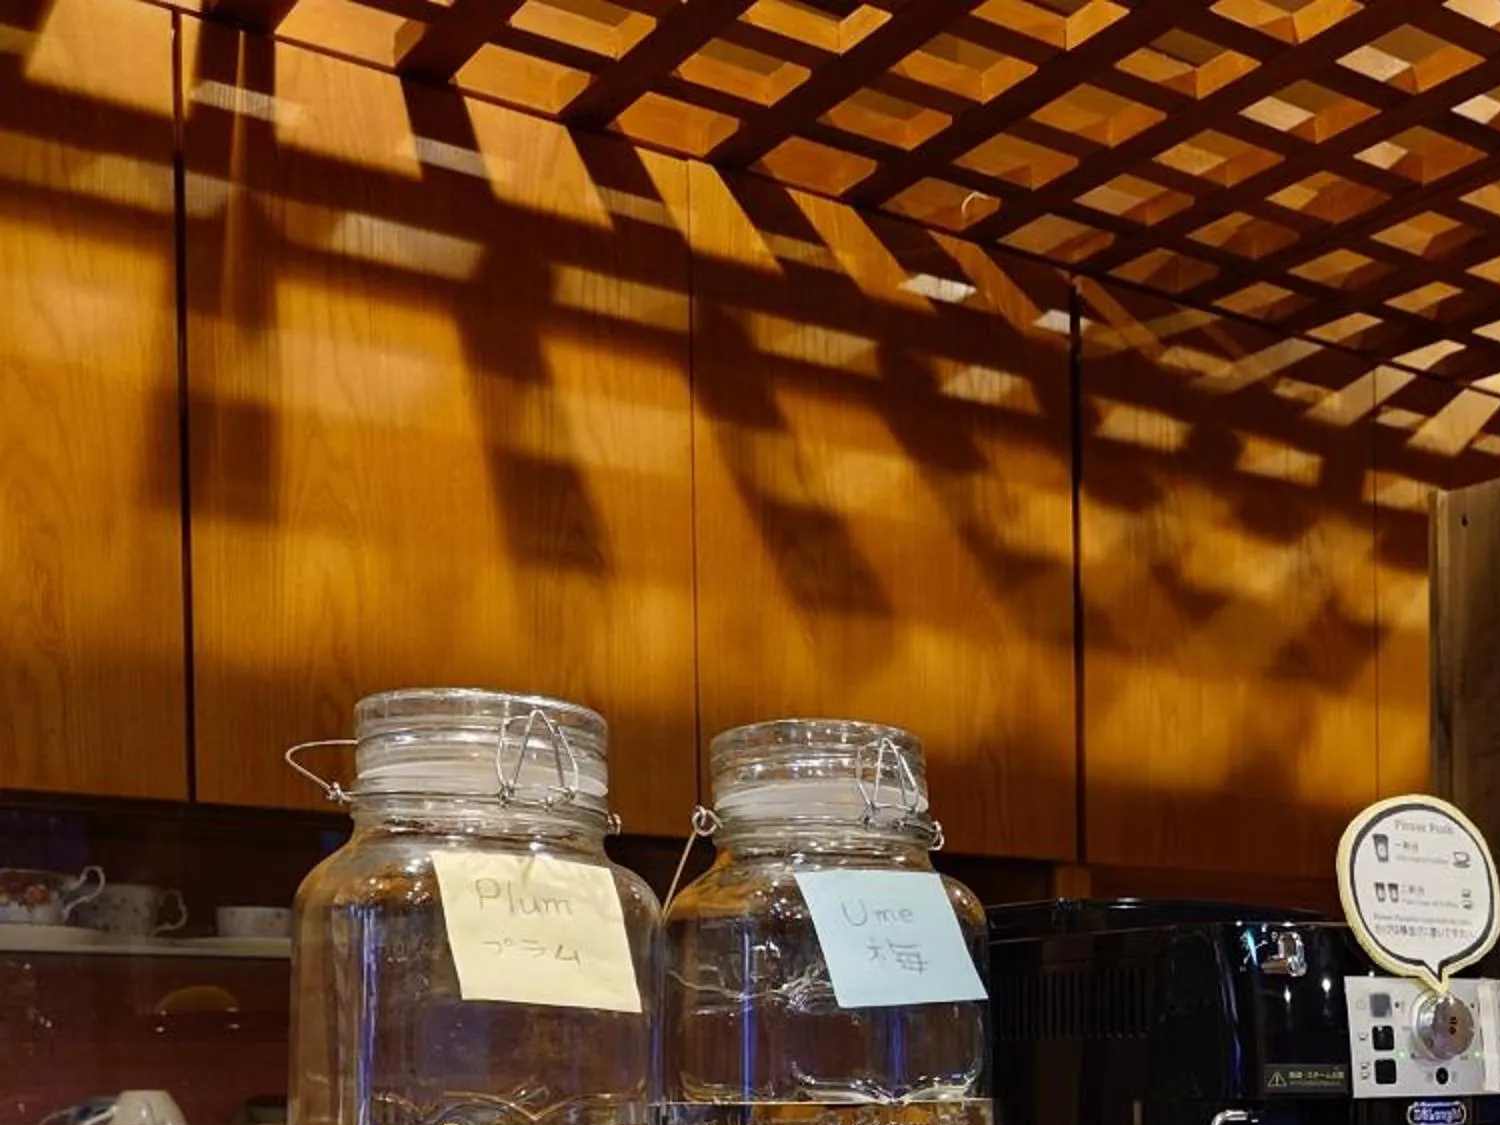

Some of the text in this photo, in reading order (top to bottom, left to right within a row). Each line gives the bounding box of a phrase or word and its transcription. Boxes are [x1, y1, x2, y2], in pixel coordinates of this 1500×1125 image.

[475, 877, 573, 915] Plum
[841, 899, 914, 927] Ume
[482, 937, 581, 965] プラム
[866, 935, 928, 975] 梅
